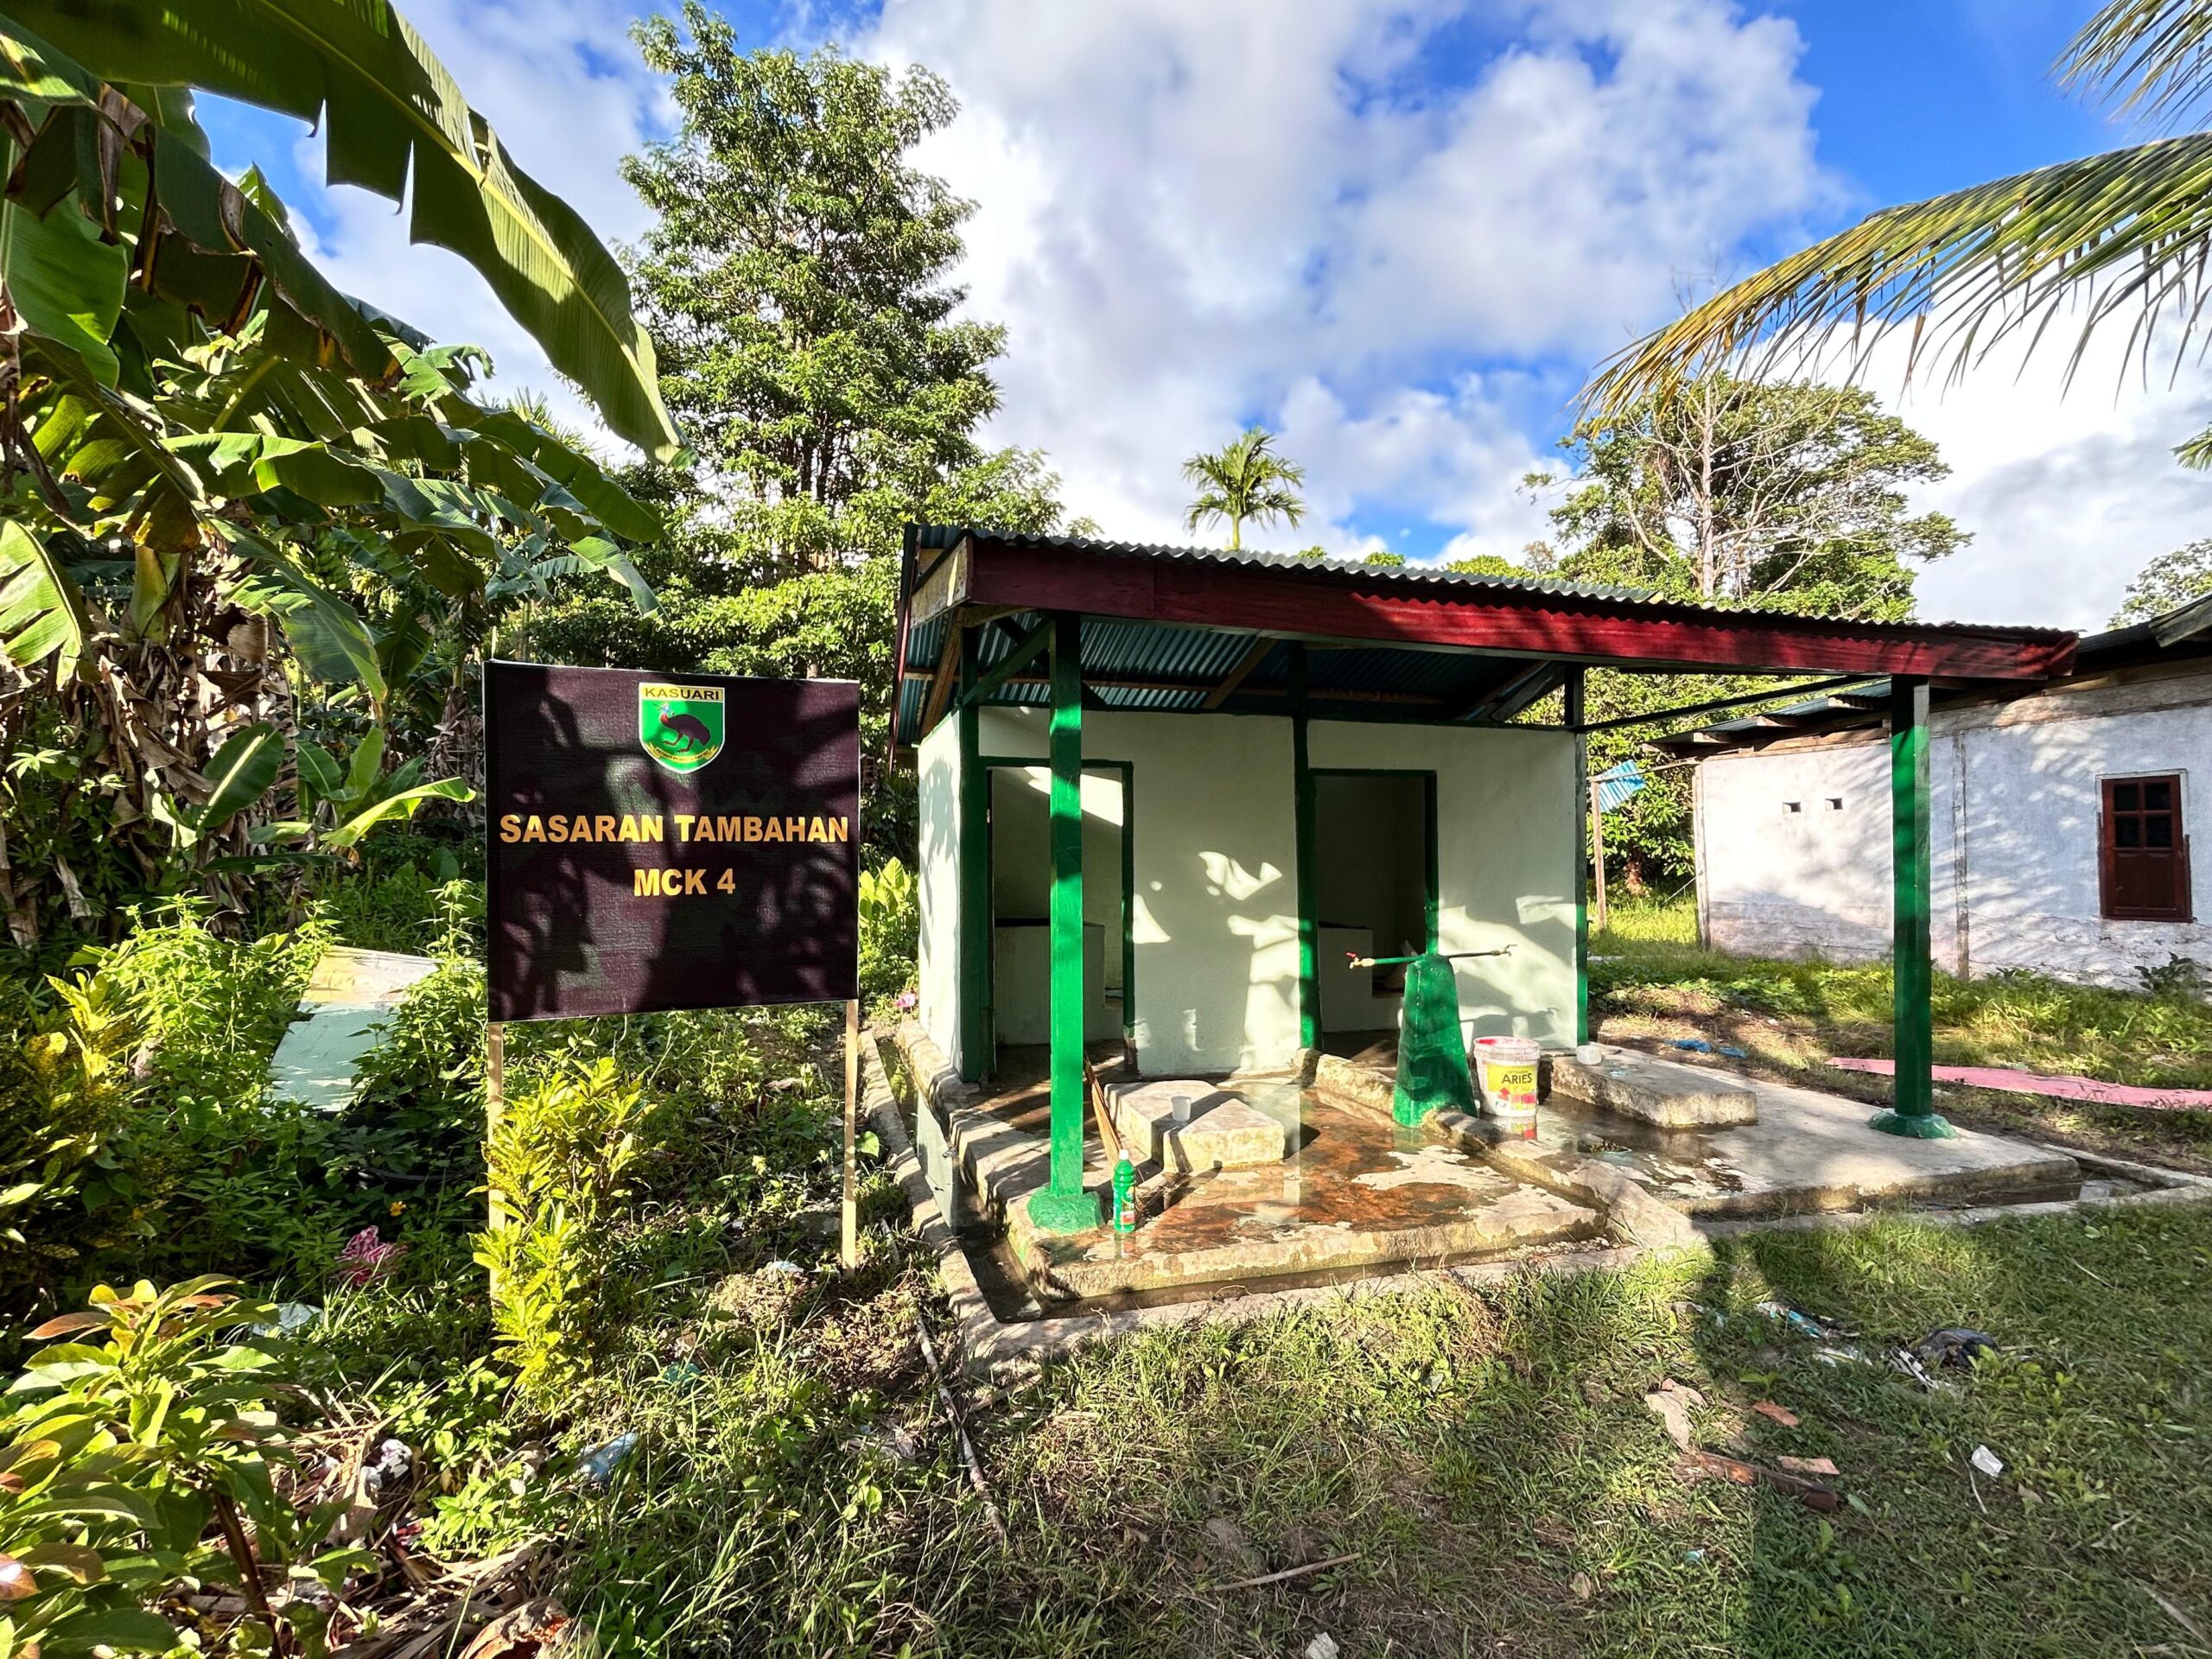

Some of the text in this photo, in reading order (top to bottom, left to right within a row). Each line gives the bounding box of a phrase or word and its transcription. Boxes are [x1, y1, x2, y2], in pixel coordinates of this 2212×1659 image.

[645, 688, 720, 701] KASUARI
[499, 815, 849, 843] SASARAN TAMBAHAN
[633, 868, 736, 897] MCK 4
[1502, 1073, 1533, 1084] ARIES
